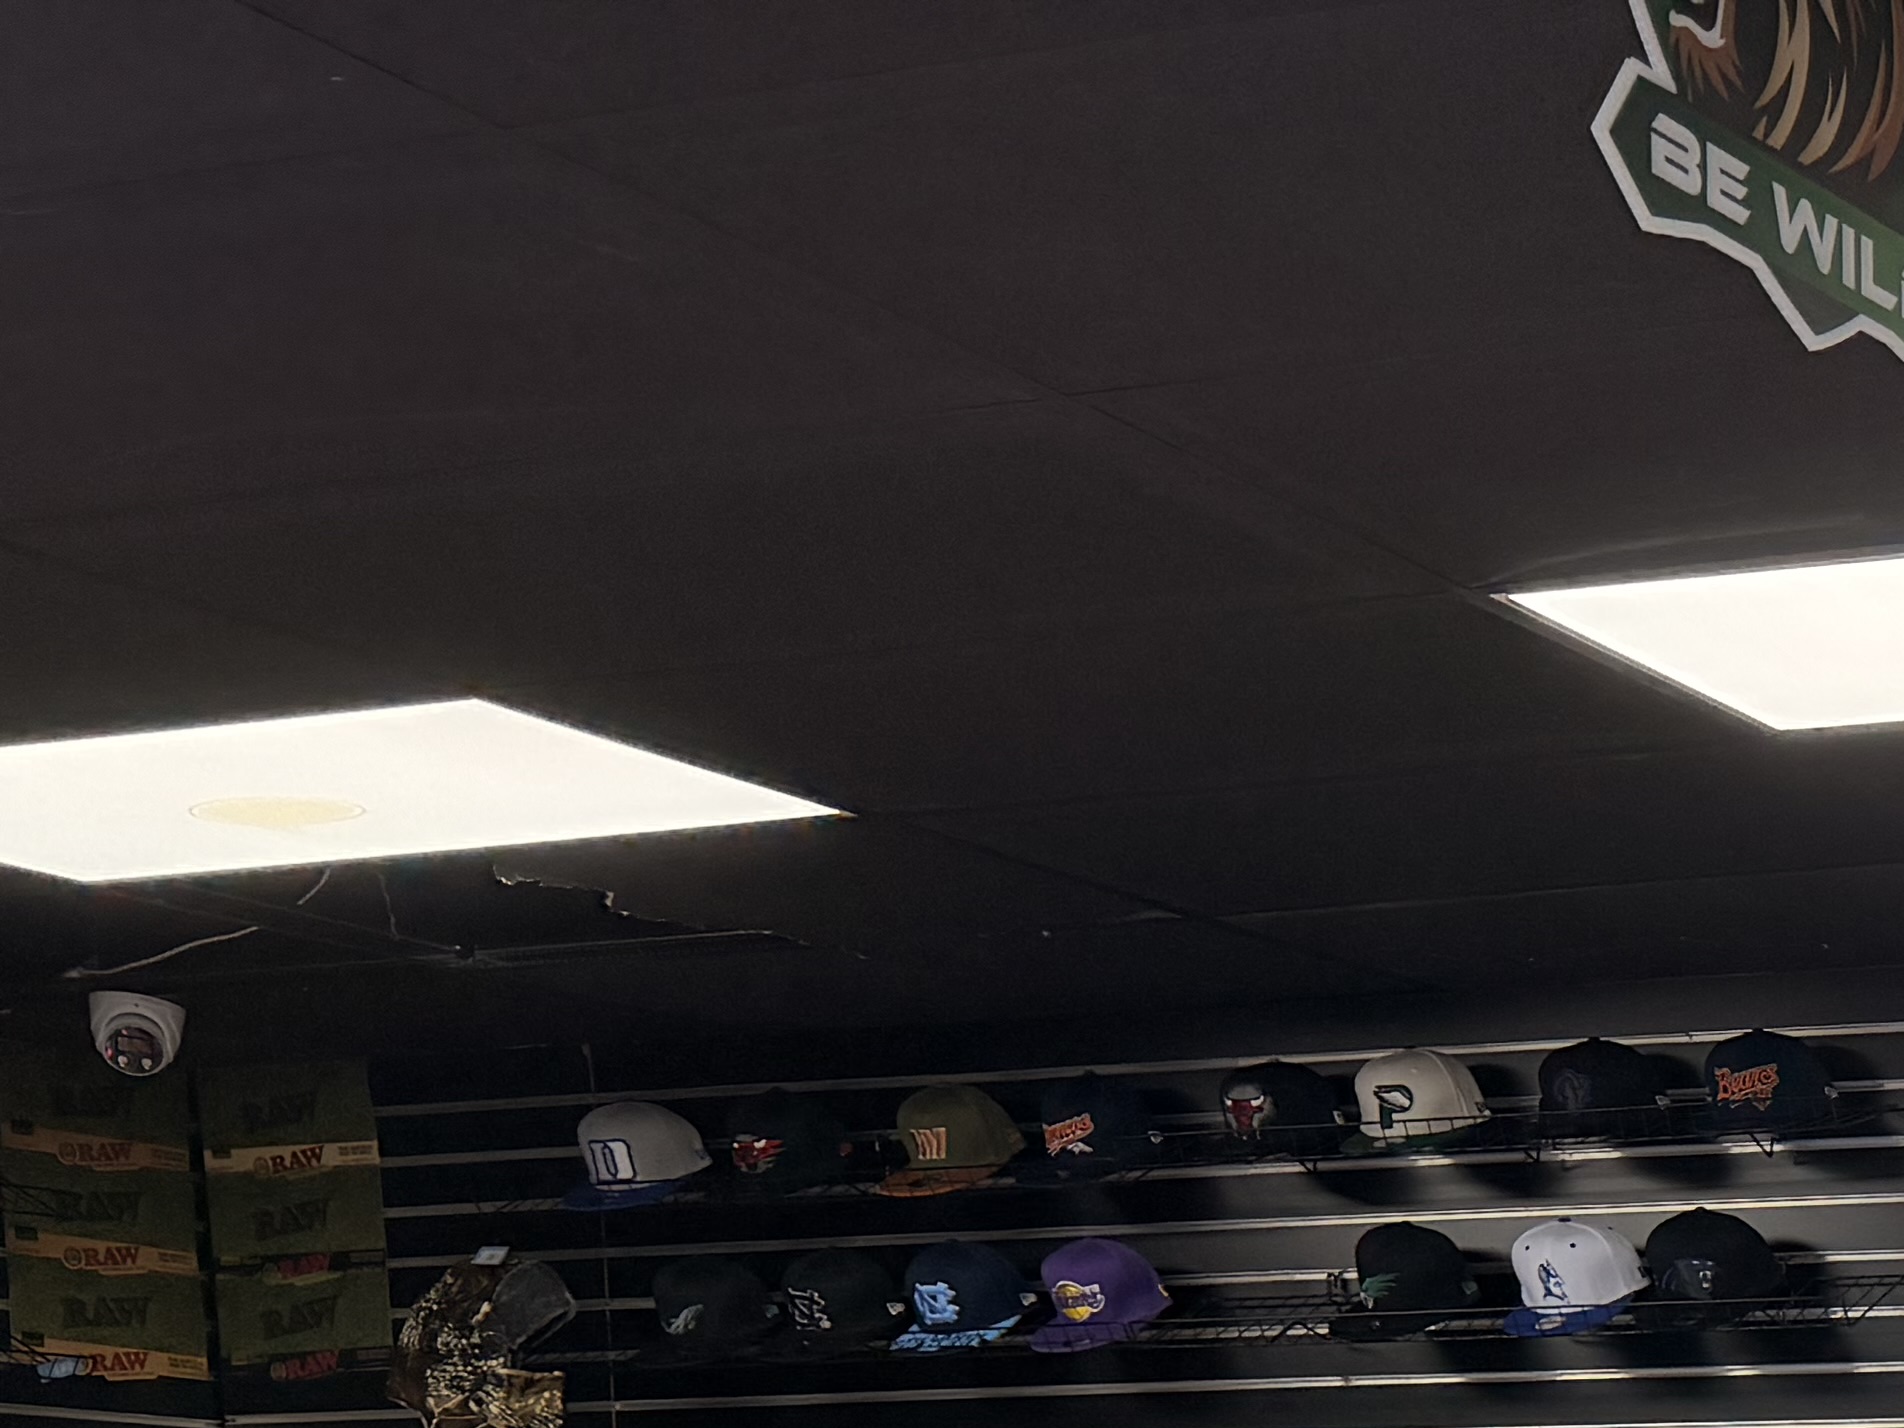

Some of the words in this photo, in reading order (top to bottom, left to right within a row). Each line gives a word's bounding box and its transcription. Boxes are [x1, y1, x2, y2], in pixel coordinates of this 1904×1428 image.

[1650, 111, 1752, 226] BE
[75, 1141, 134, 1163] RAW
[269, 1145, 325, 1174] RAW
[82, 1245, 141, 1269] RAW
